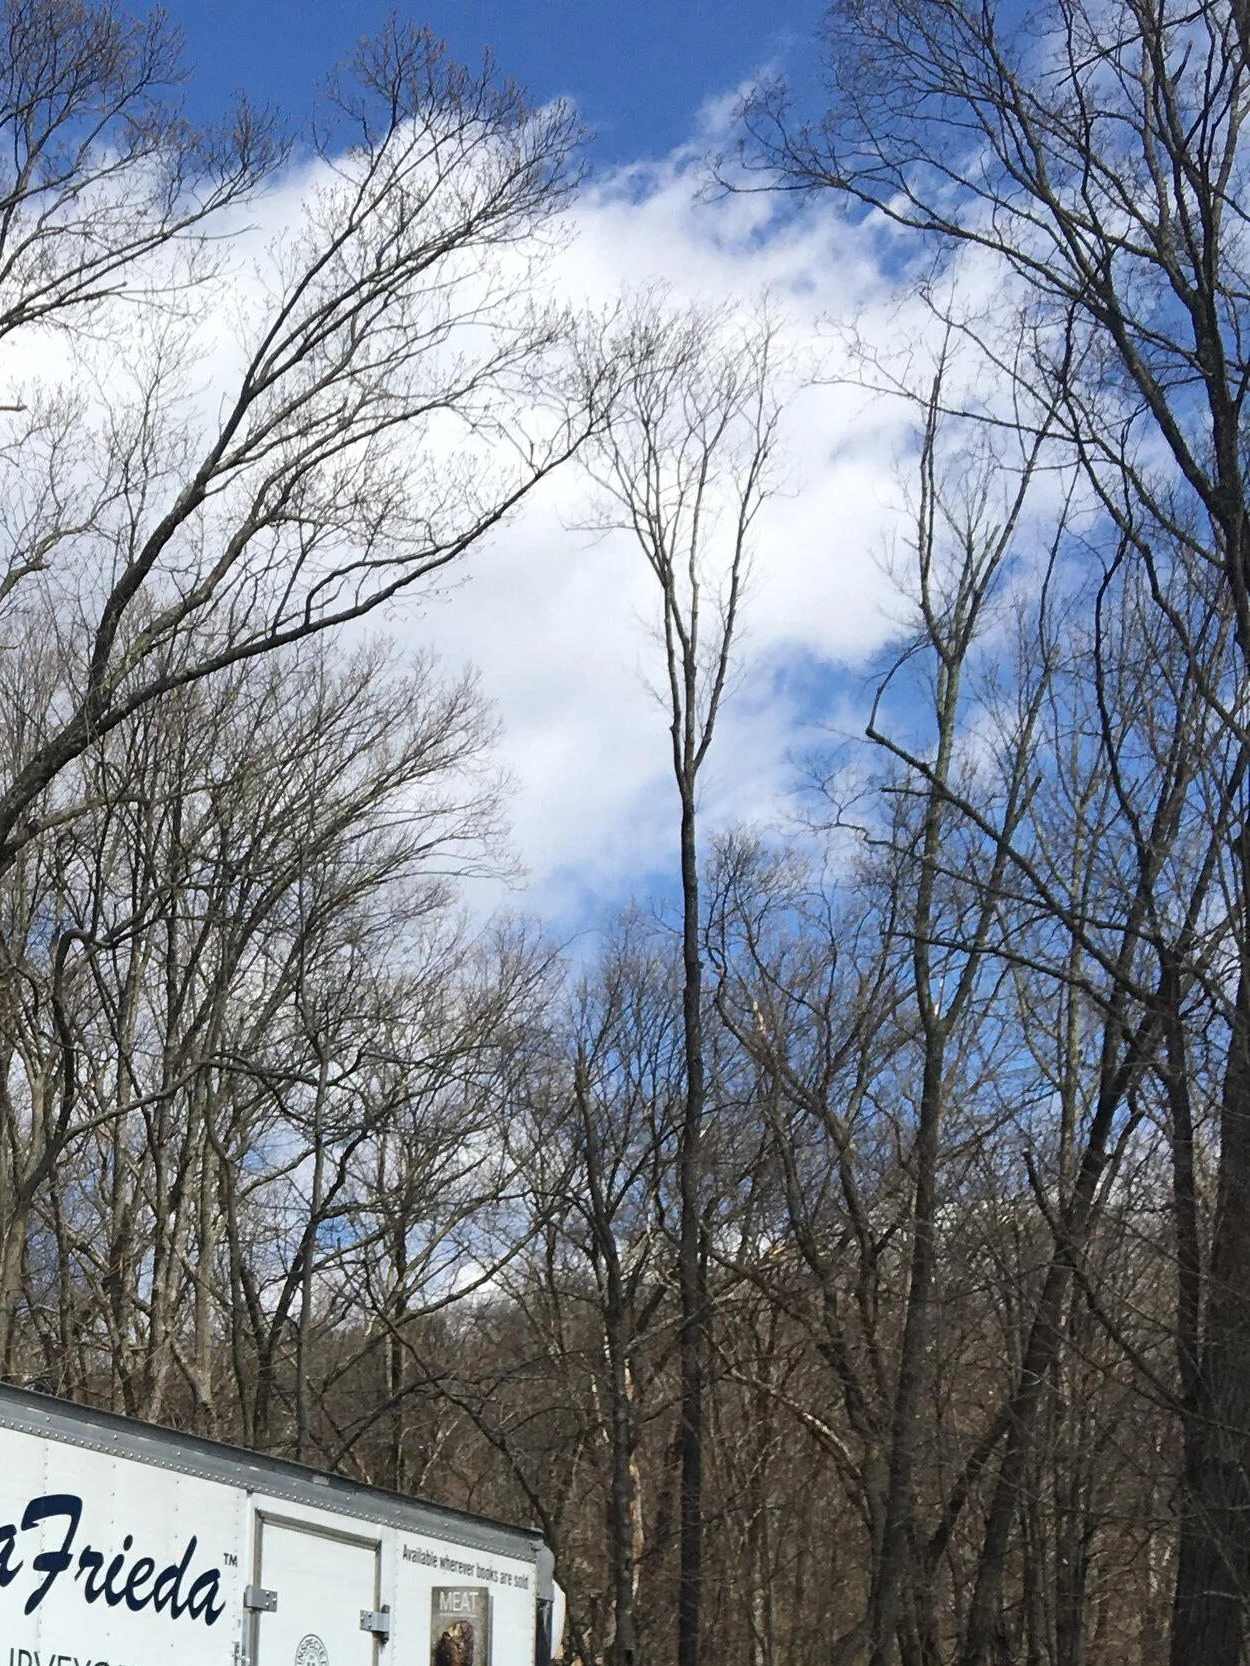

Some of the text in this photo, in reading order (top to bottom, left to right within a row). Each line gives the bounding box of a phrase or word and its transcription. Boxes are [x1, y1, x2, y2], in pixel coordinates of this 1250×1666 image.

[402, 1544, 529, 1590] Available wherever books are sold
[439, 1591, 479, 1612] MEAT
